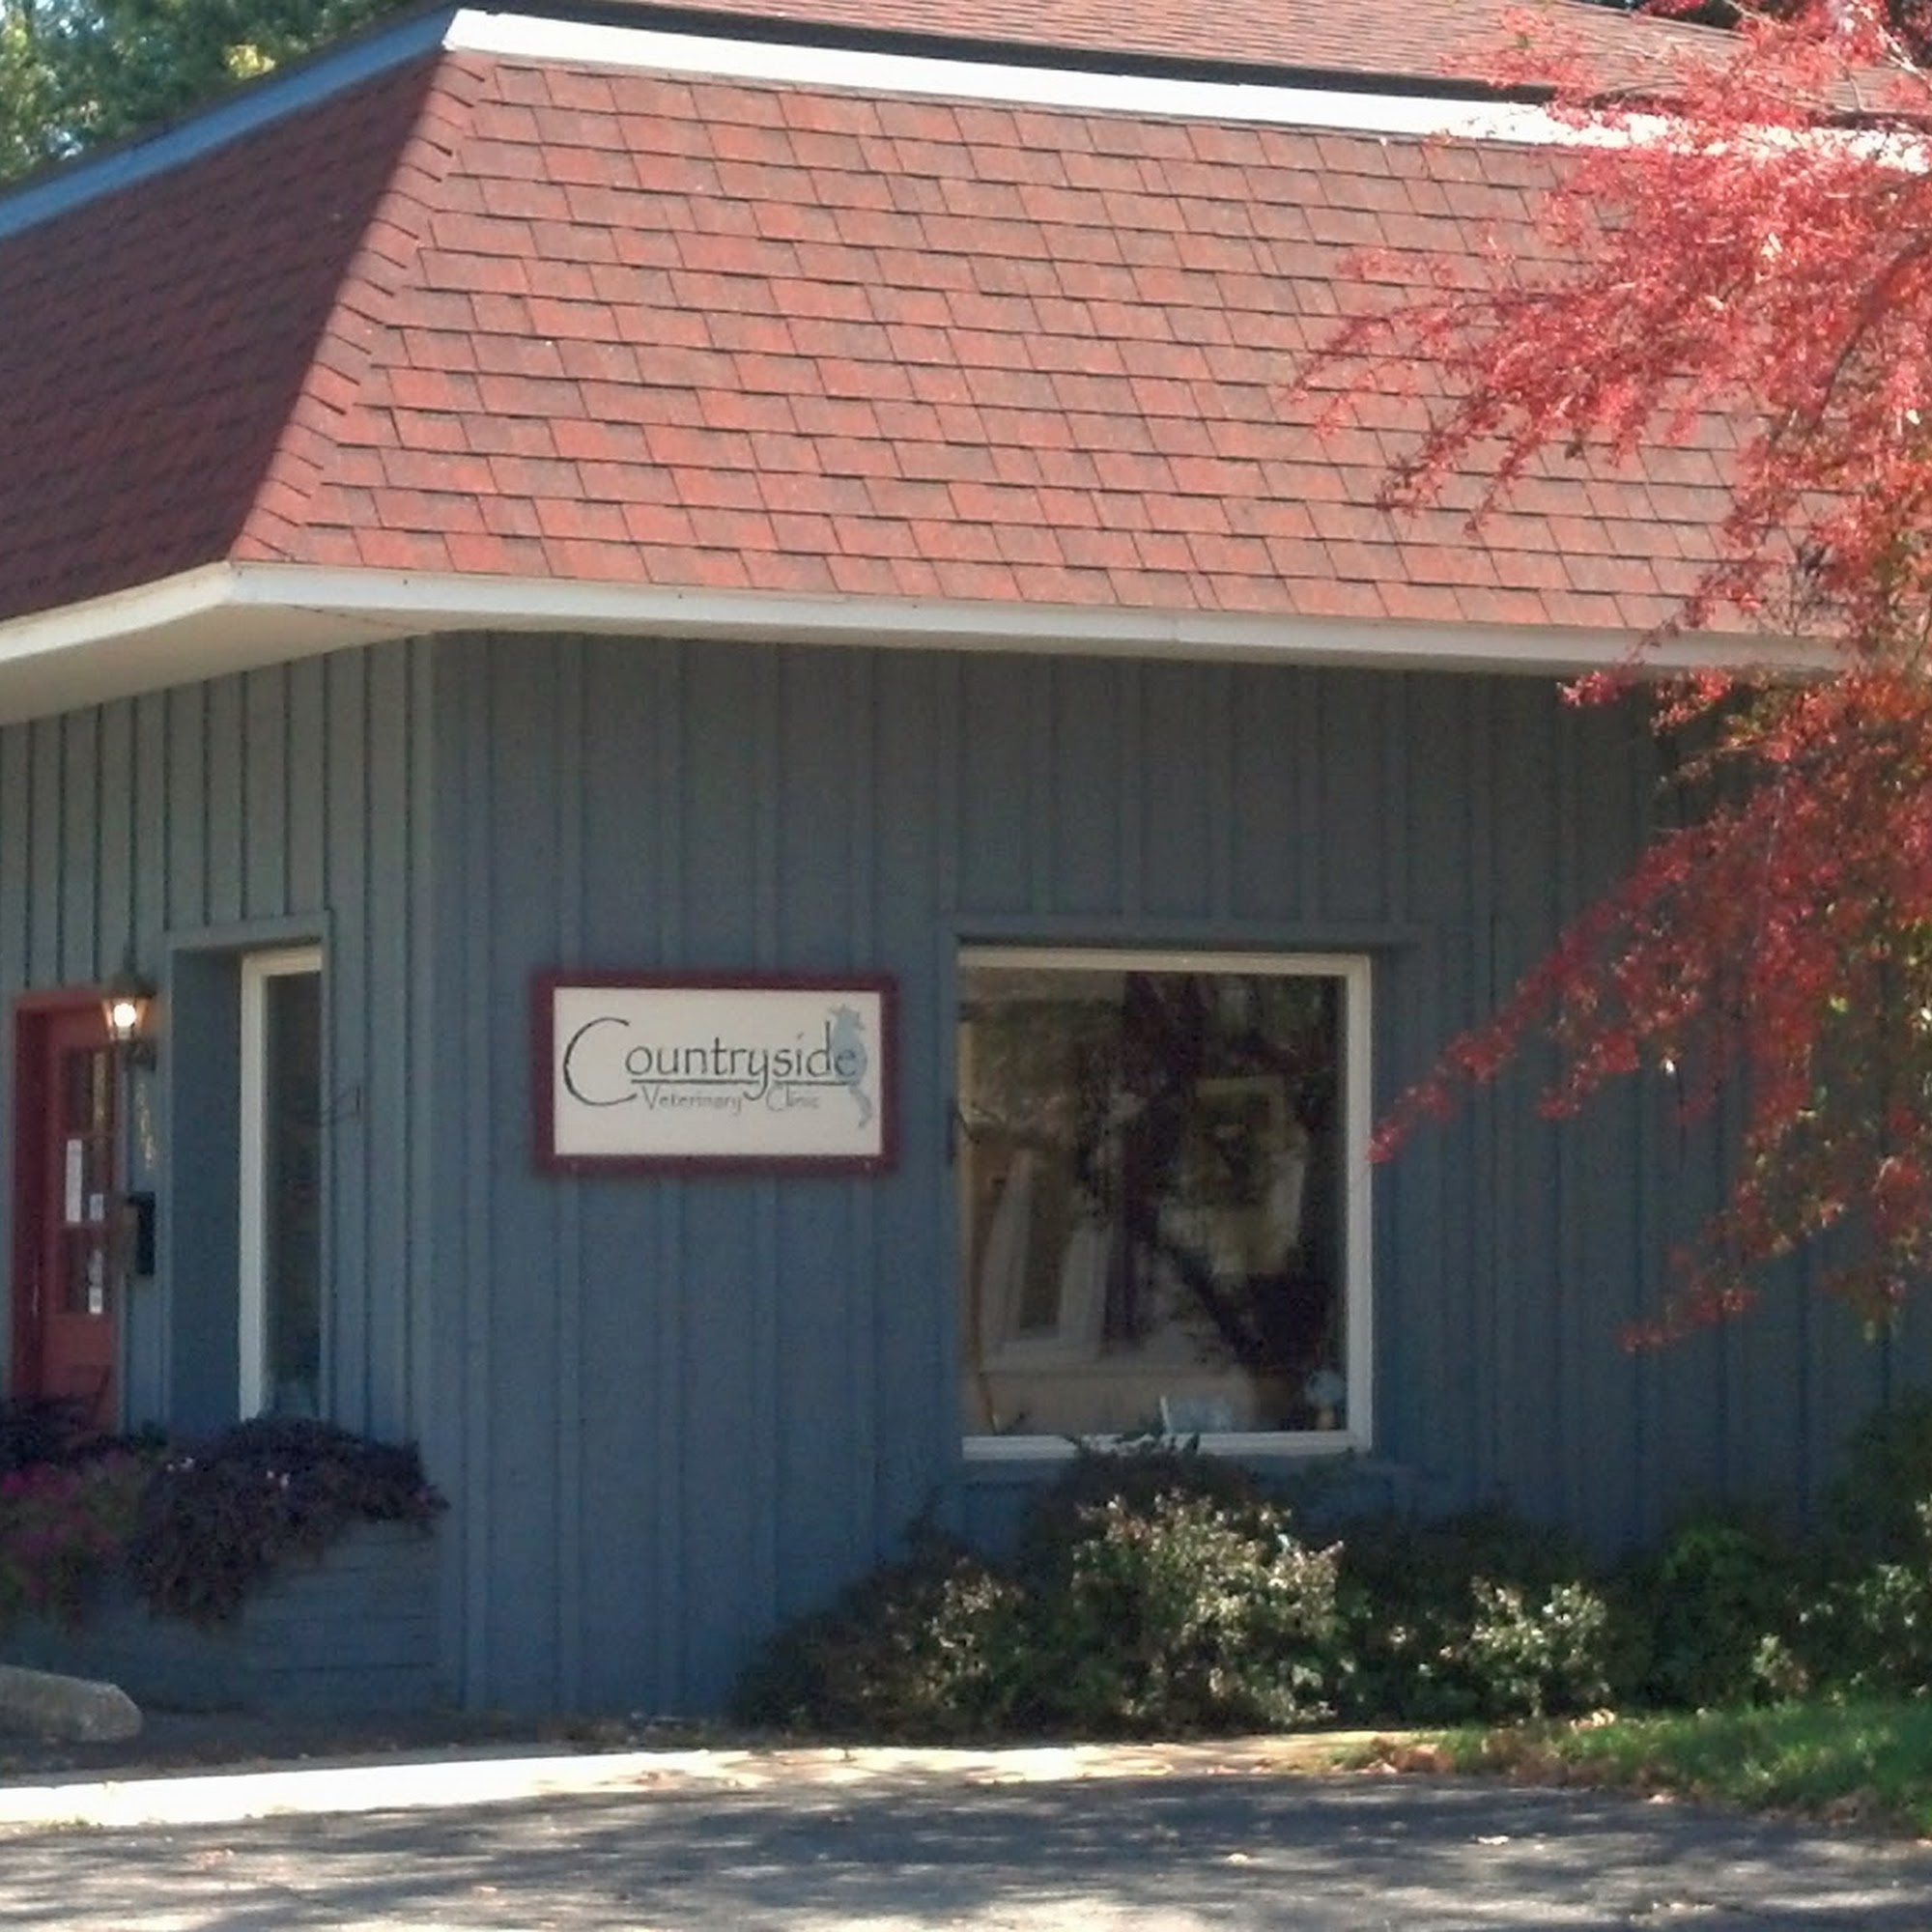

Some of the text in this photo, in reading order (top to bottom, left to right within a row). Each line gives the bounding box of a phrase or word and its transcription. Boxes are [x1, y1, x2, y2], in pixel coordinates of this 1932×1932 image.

[563, 1017, 858, 1107] Countryside
[641, 1084, 820, 1116] Veterinary Clinic
